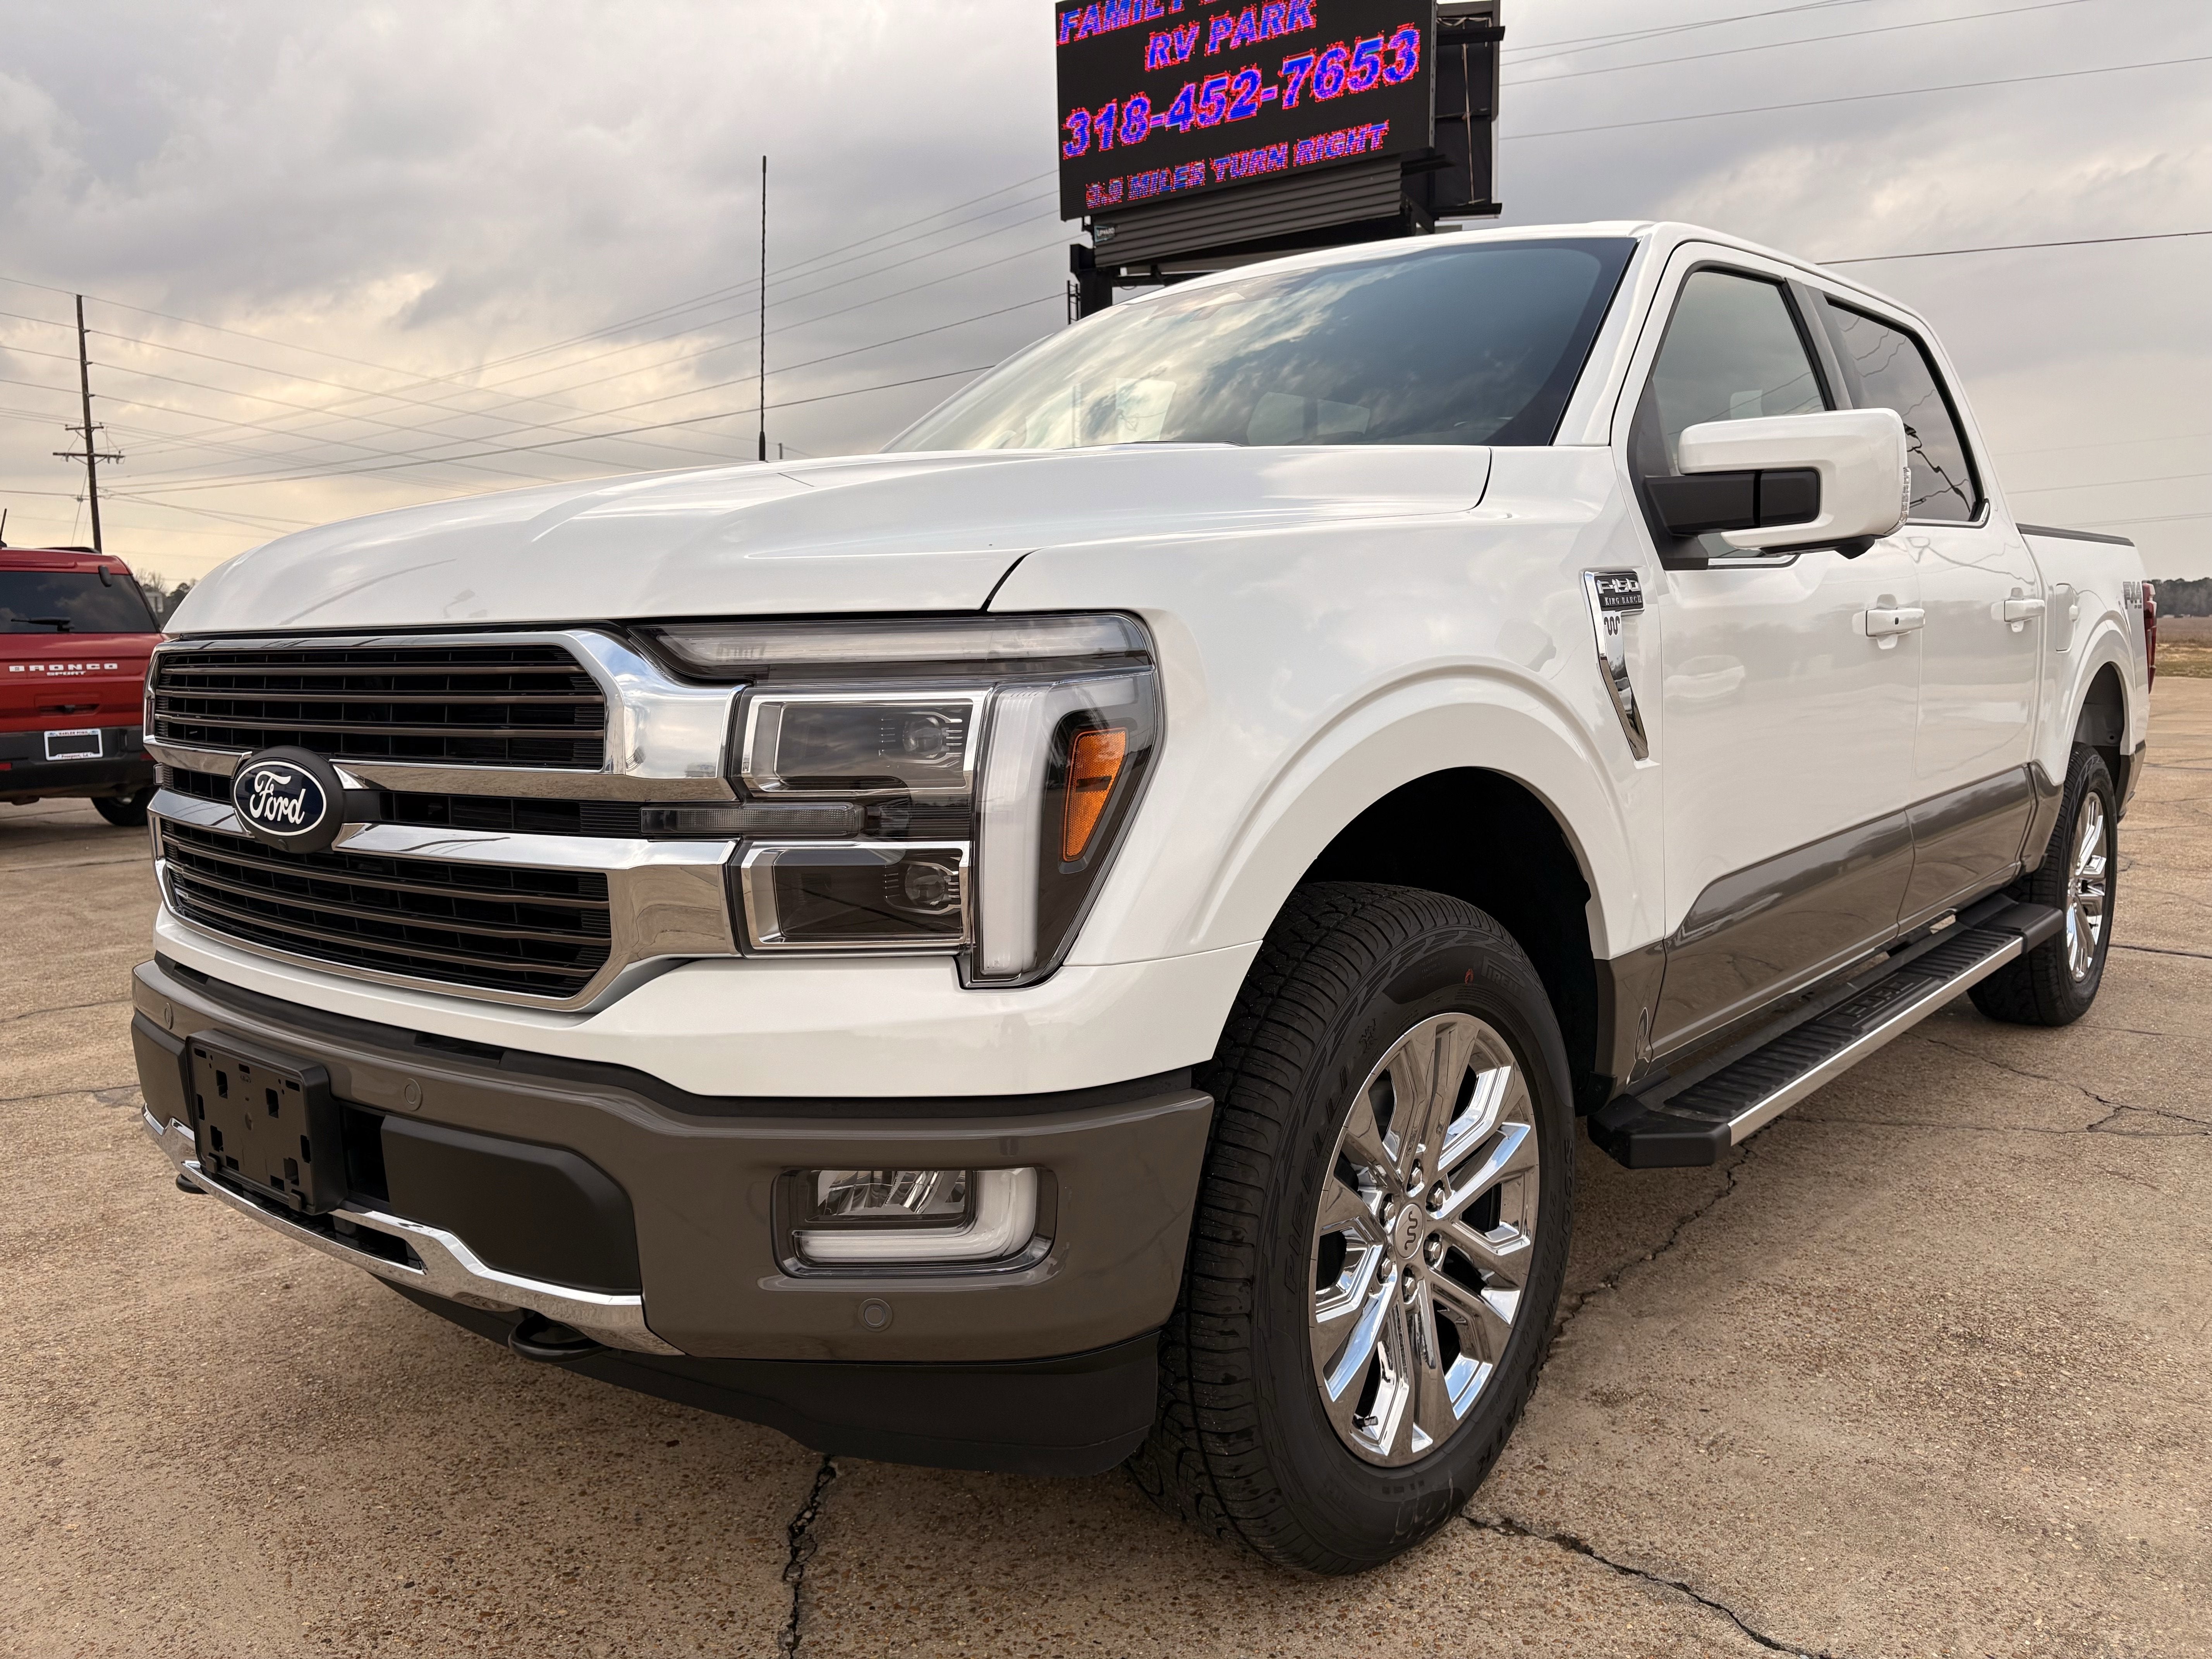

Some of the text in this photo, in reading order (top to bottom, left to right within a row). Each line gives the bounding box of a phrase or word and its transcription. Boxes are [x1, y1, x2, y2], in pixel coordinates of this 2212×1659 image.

[1145, 0, 1317, 71] RV PARK
[1062, 22, 1420, 160] 318-452-7653
[1127, 160, 1206, 201] MILES
[1209, 142, 1289, 183] TURN
[1293, 120, 1389, 167] RIGHT
[1597, 578, 1640, 594] F-150
[1604, 595, 1642, 605] KING RANCH
[2123, 581, 2142, 610] FX4
[9, 663, 118, 672] BRONCO
[250, 770, 306, 824] Ford
[1285, 1065, 1348, 1295] PIRELLI
